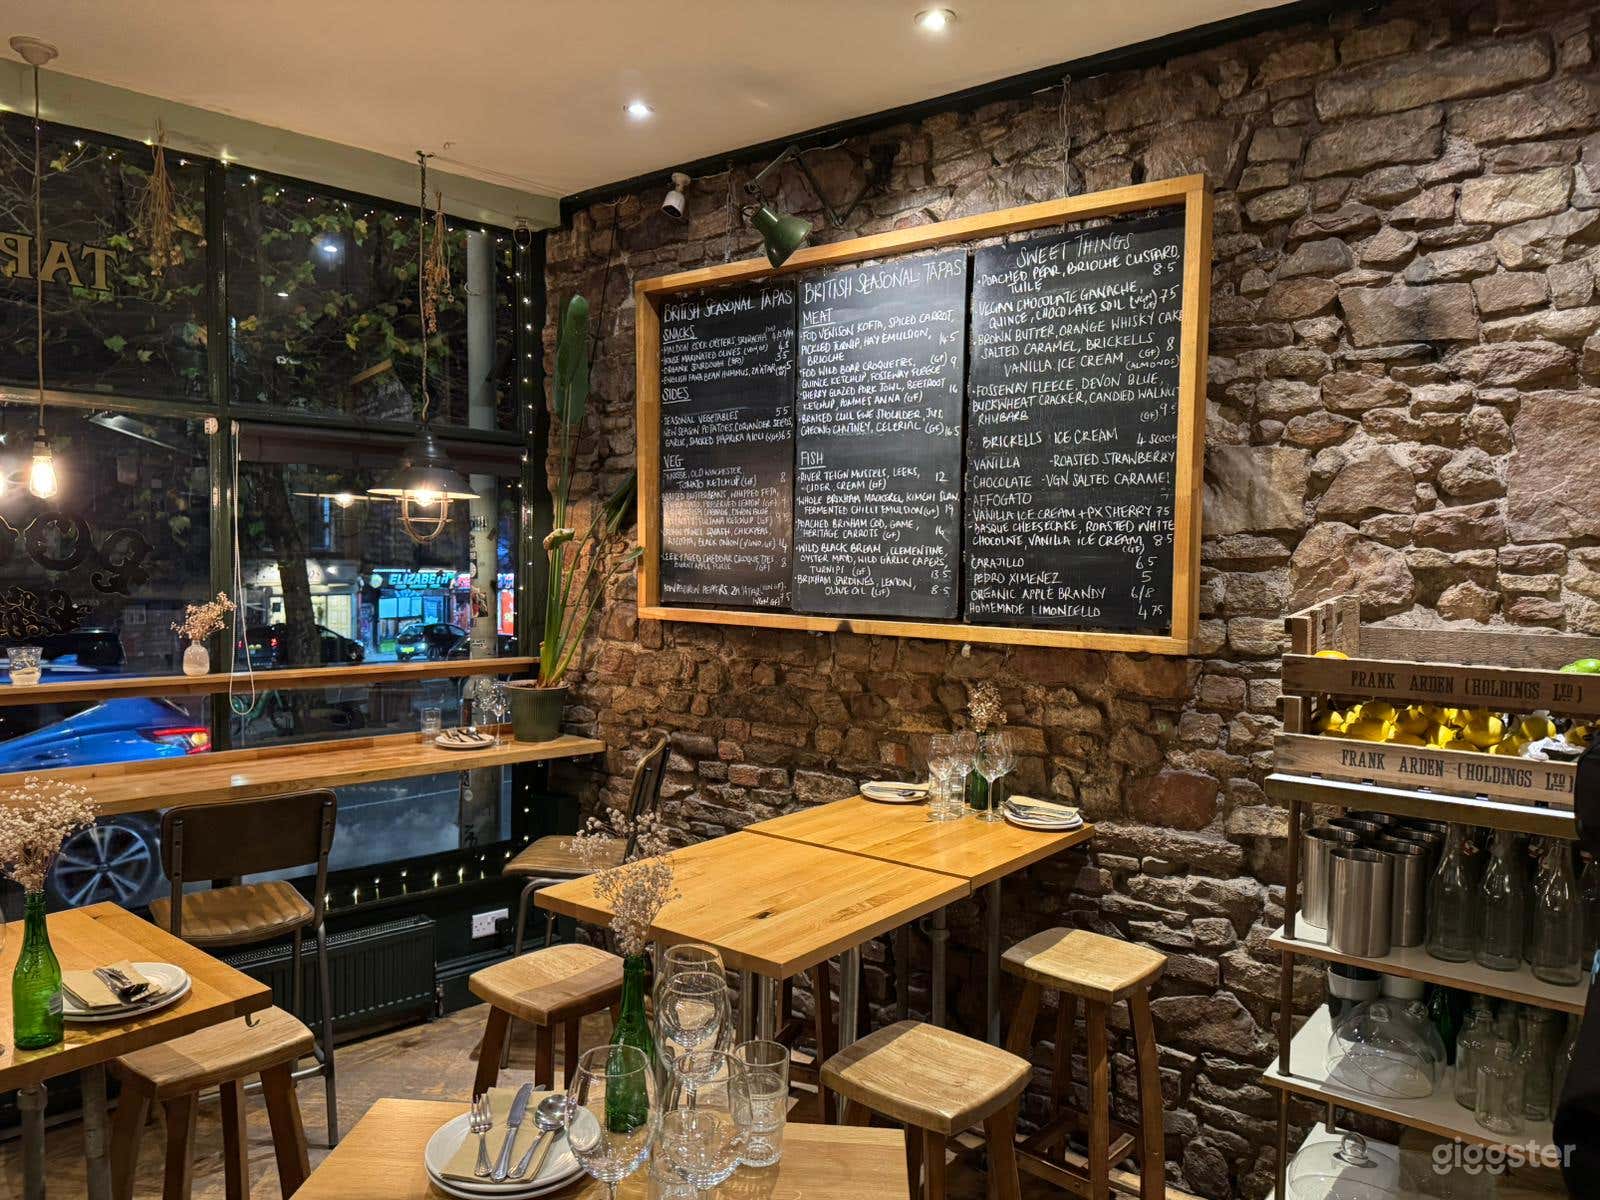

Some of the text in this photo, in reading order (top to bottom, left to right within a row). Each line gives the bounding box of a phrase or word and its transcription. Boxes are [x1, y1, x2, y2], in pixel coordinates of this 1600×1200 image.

[1016, 232, 1135, 269] SWEET THINGS
[981, 245, 1181, 287] POACHED PEAR, BRIOCHE CUSTARD,
[804, 259, 962, 305] BRITISH SEASONAL TAPAS
[1008, 281, 1042, 295] TUILE
[664, 288, 793, 323] BRITISH SEASONAL TAPAS
[979, 281, 1143, 317] VEGAN CHOCOLATE GANACHE,
[803, 307, 834, 326] MEAT
[989, 299, 1126, 330] QUINCE, CHOCOLATE SOIL
[663, 325, 695, 342] SNACKS
[819, 326, 854, 340] VENISON
[888, 315, 917, 329] SPICED
[979, 330, 1012, 346] BROWN
[1015, 325, 1058, 341] BUTTER,
[1060, 320, 1105, 337] ORANGE
[1111, 312, 1154, 330] WHISKY
[801, 343, 831, 356] PICKLED
[863, 335, 880, 347] HAY
[981, 332, 1156, 360] SALTED CARAMEL, BRICKELLS
[1166, 336, 1176, 352] 8
[807, 352, 845, 367] BRIOCHE
[1138, 346, 1161, 360] (GF)
[818, 365, 838, 377] WILD
[840, 362, 861, 374] BOAR
[1004, 352, 1124, 377] VANILLA ICE CREAM
[802, 390, 828, 401] SHERRY
[829, 386, 856, 398] GLAZED
[858, 384, 878, 394] PORK
[976, 372, 1164, 398] FOSSEWAY DEVON BLUE,
[662, 387, 690, 401] SIDES
[874, 394, 901, 405] ANNA
[972, 389, 1135, 413] BUCKWHEAT CRACKER, CANDIED
[699, 411, 740, 424] VEGETABLES
[856, 409, 875, 420] EWE
[978, 410, 1030, 425] RHUBARB
[982, 427, 1147, 449] BRICKELLS ICE CREAM 4
[664, 455, 684, 469] VEG
[800, 451, 824, 467] FISH
[974, 456, 1021, 471] VANILLA
[1102, 449, 1176, 465] STRAWBERRY
[824, 469, 849, 481] TEIGN
[893, 467, 921, 480] LEEKS,
[935, 471, 950, 483] 12
[973, 475, 1032, 489] CHOCOLATE
[1072, 472, 1110, 487] SALTED
[836, 480, 866, 490] CREAM
[798, 496, 823, 506] WHOLE
[906, 491, 936, 502] KIMCHI
[973, 492, 1032, 507] AFFOGATO
[804, 505, 849, 516] FERMENTED
[851, 505, 879, 515] CHILLI
[973, 505, 1152, 522] VANILLA ICE CREAM SHERRY
[832, 518, 868, 529] BRIXHAM
[974, 519, 1176, 535] BASQUE CHEESECAKE, ROASTED WHITE
[803, 528, 840, 539] HERITAGE
[843, 528, 879, 539] CARROTS
[1029, 534, 1072, 547] VANILLA
[798, 542, 882, 554] WILD BLACK BREAM
[800, 554, 910, 565] OYSTER WILD GARLIC
[971, 555, 1025, 569] CARAJILLO
[810, 565, 845, 575] TURNIPS
[974, 570, 1153, 586] PEDRO XIMENEZ 5
[825, 586, 867, 596] OLIVE OIL
[971, 588, 1017, 601] ORGANIC
[1022, 586, 1053, 600] APPLE
[1058, 585, 1106, 600] BRANDY
[969, 602, 1101, 618] HOMEMADE LIMONCELLO
[1351, 671, 1395, 690] FRANK
[1410, 675, 1454, 694] ARDEN
[1341, 750, 1385, 770] FRANK
[1400, 756, 1444, 777] ARDEN
